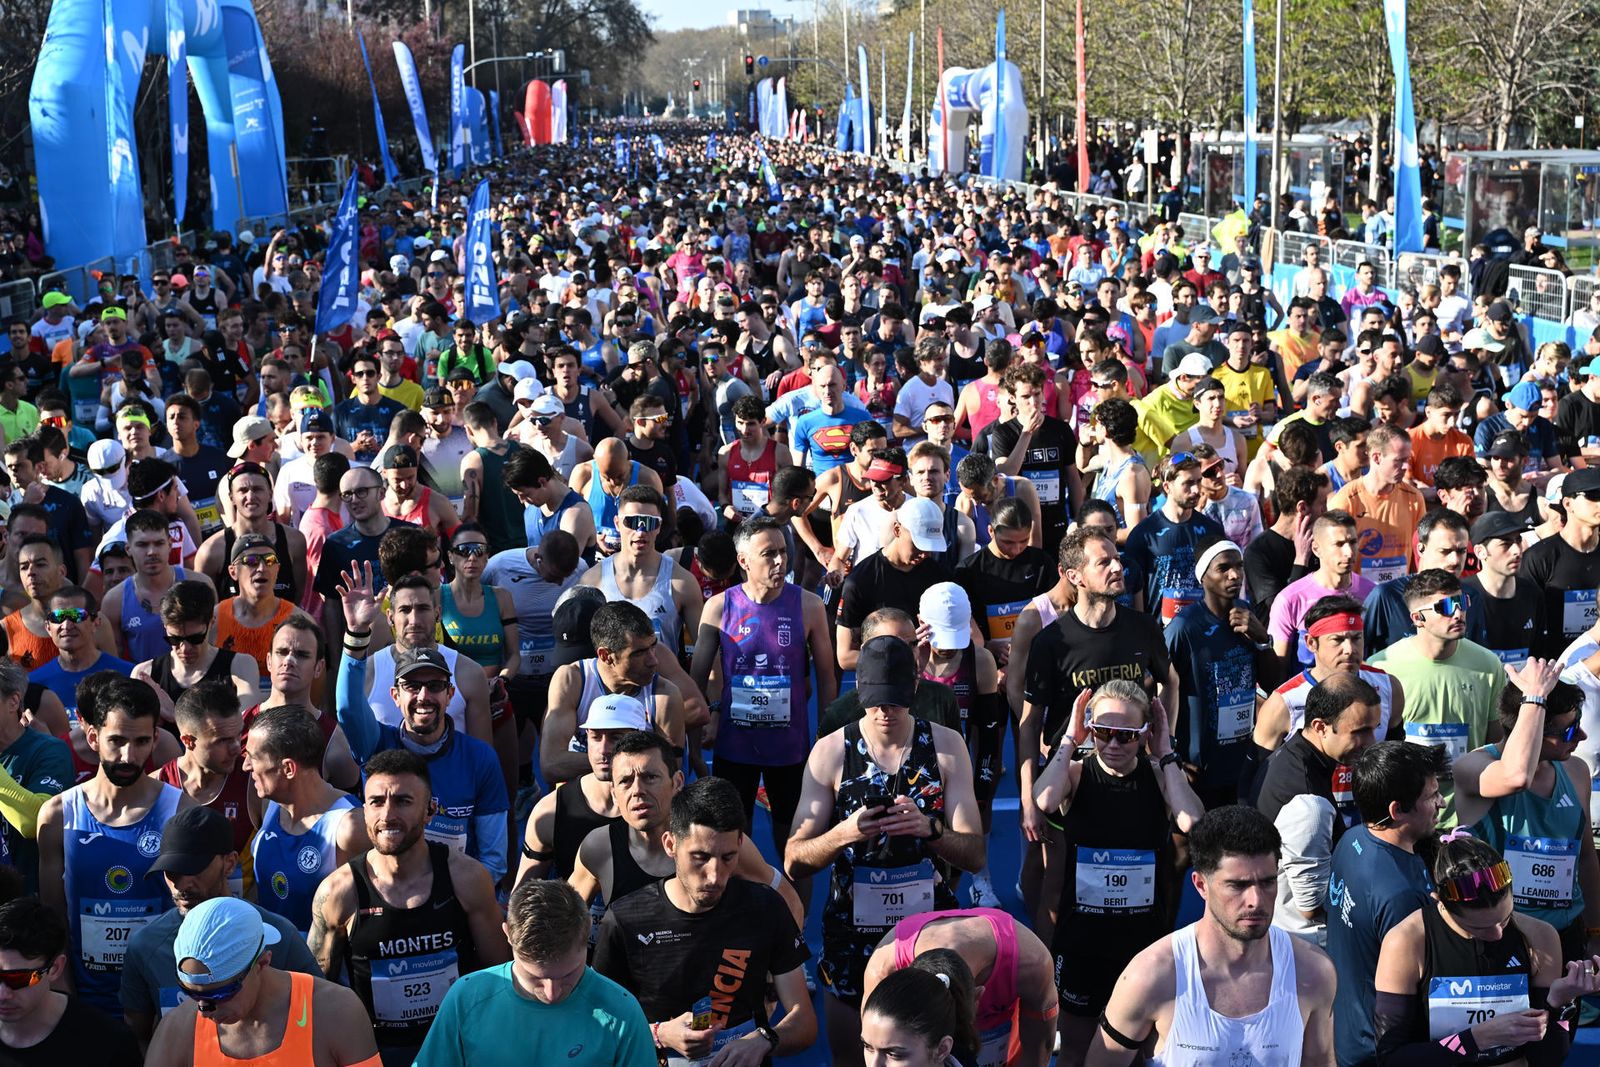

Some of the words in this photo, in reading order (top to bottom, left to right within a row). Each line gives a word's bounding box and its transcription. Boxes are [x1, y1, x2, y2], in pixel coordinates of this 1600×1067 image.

[471, 241, 494, 307] 1:20
[1379, 572, 1392, 581] 366
[739, 625, 751, 635] kp
[530, 655, 545, 664] 708
[1072, 663, 1142, 687] KRITERIA
[751, 696, 769, 705] 293
[1237, 710, 1250, 720] 363
[1113, 854, 1142, 862] movistar
[890, 871, 919, 880] movistar
[1531, 863, 1555, 878] 686
[1104, 874, 1127, 887] 190
[1521, 886, 1559, 898] LEANDRO
[881, 892, 904, 905] 701
[1104, 898, 1128, 906] BERIT
[115, 904, 146, 913] movistar
[105, 927, 131, 941] 207
[379, 931, 453, 957] MONTES
[103, 953, 127, 962] RIVE
[412, 960, 444, 969] movistar
[403, 982, 431, 998] 523
[1477, 982, 1512, 991] movistar
